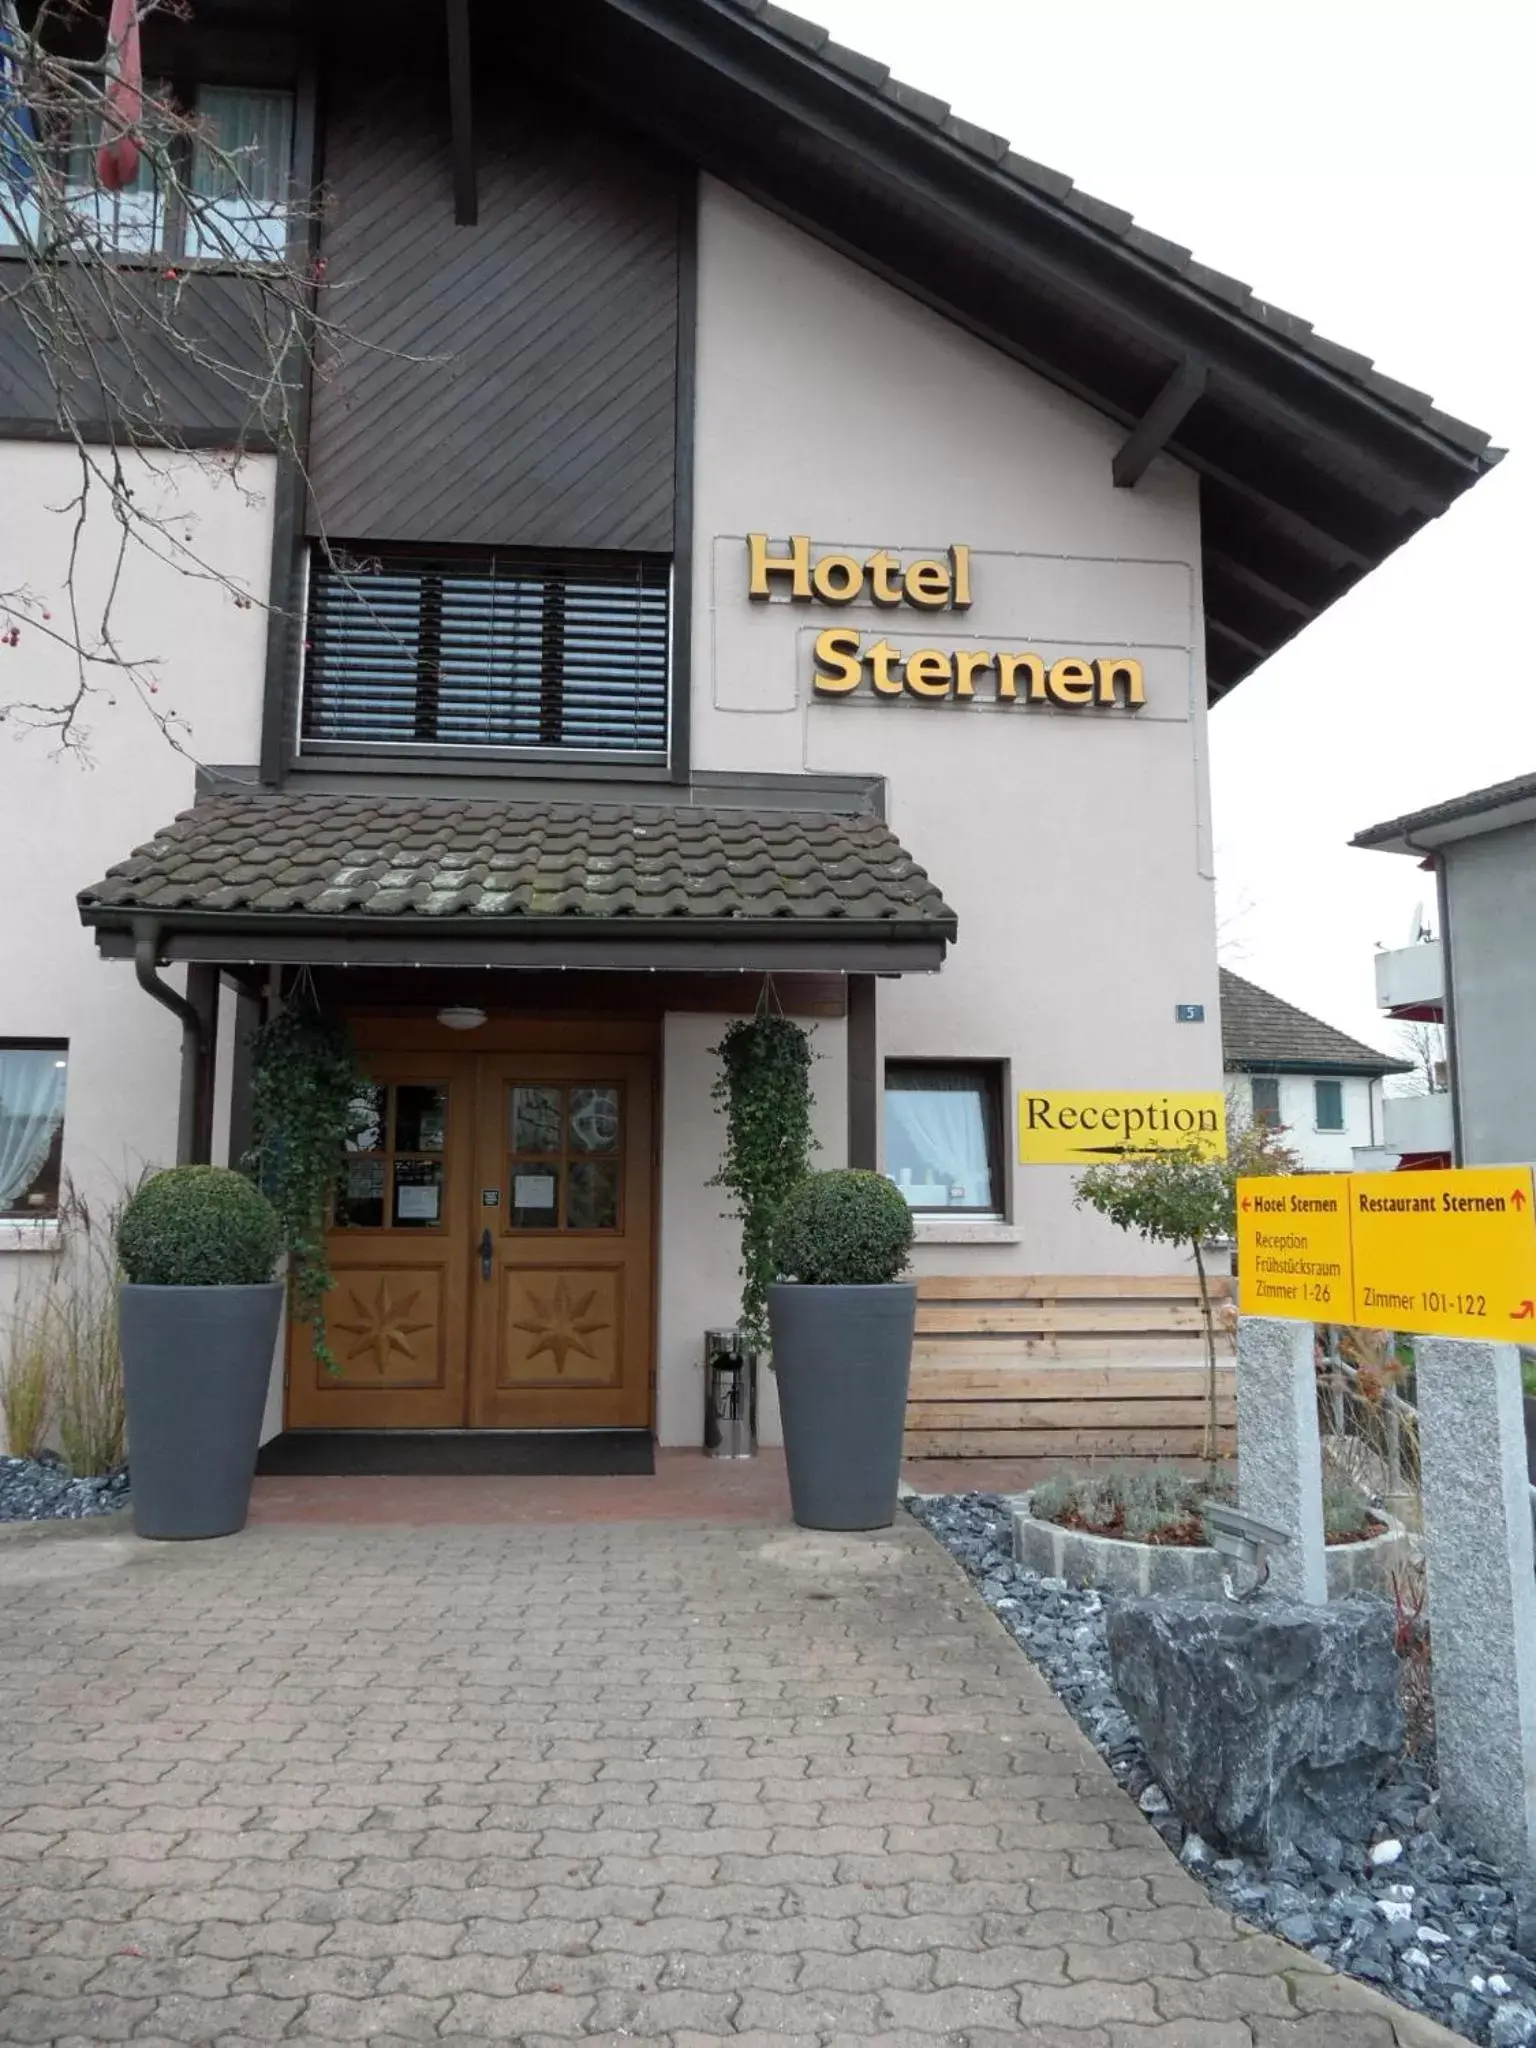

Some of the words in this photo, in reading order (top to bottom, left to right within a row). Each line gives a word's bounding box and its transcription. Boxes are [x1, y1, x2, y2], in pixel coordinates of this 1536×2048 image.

[747, 533, 972, 609] Hotel
[813, 628, 1147, 709] Sternen
[1186, 1006, 1195, 1019] 5
[1027, 1097, 1218, 1140] Reception
[1254, 1195, 1287, 1212] Hotel
[1290, 1194, 1338, 1212] Sternen
[1359, 1193, 1436, 1212] Restaurant
[1443, 1192, 1506, 1212] Sternen
[1255, 1231, 1308, 1252] Reception
[1255, 1255, 1341, 1277] Frühstücksraum
[1255, 1279, 1298, 1299] Zimmer
[1303, 1283, 1331, 1303] 1-26
[1363, 1286, 1415, 1310] Zimmer
[1421, 1291, 1487, 1317] 101-122
